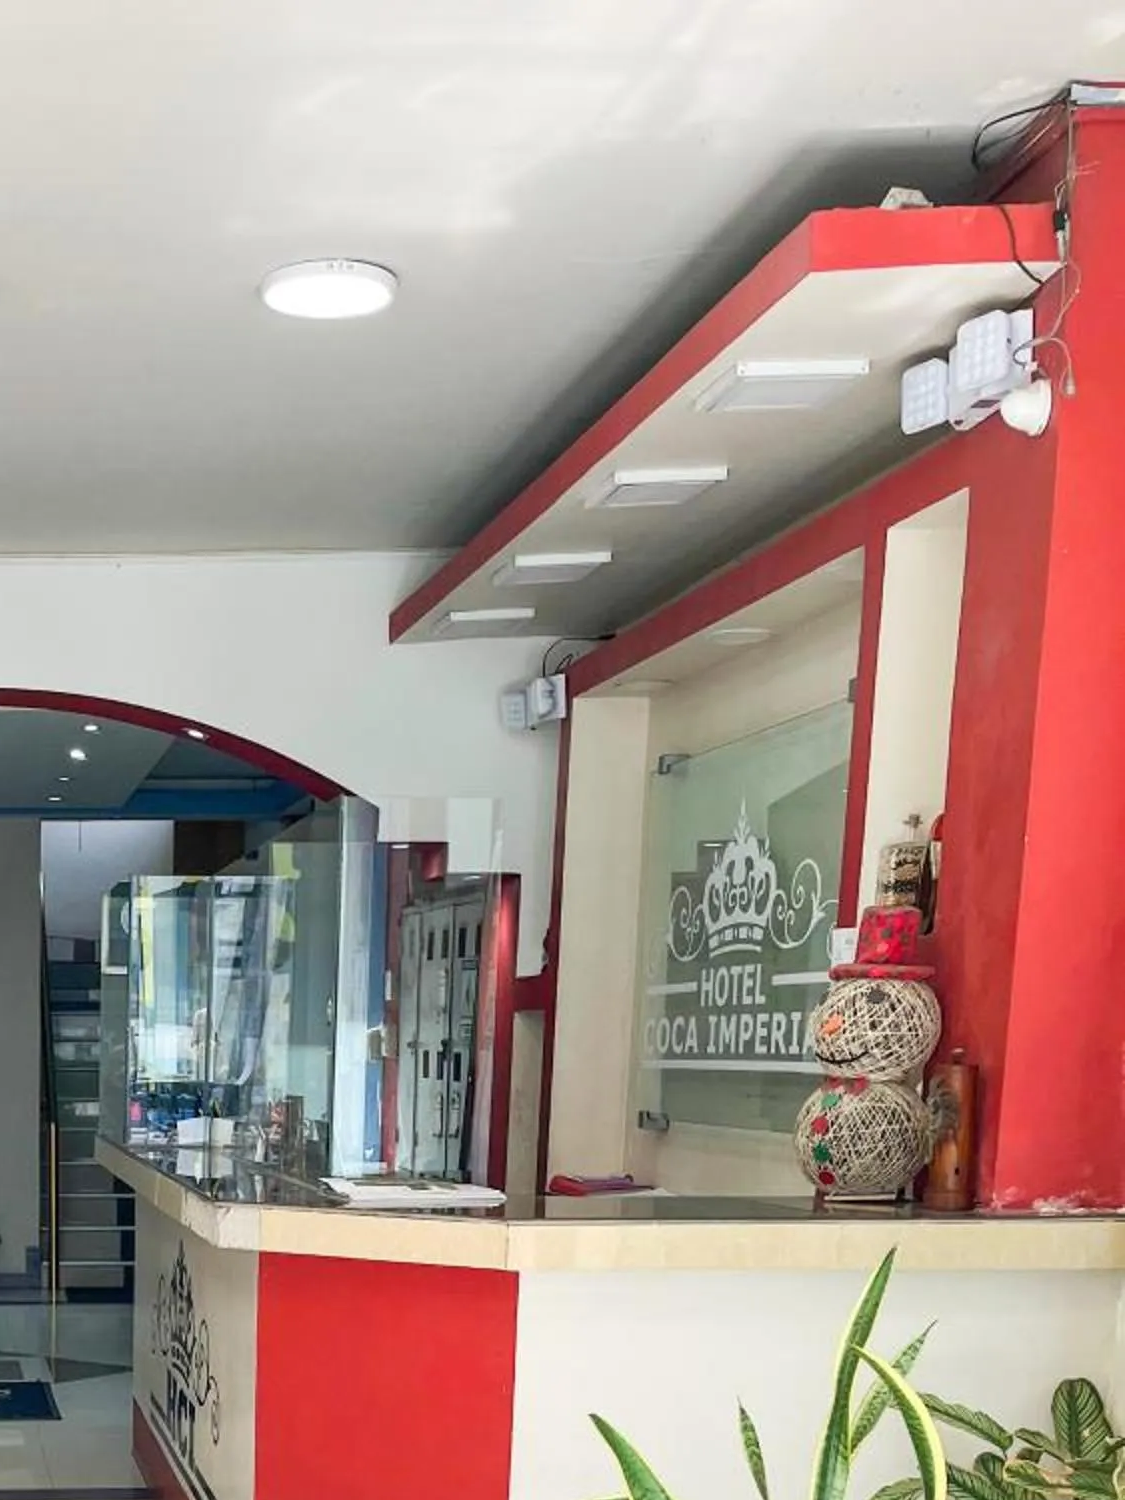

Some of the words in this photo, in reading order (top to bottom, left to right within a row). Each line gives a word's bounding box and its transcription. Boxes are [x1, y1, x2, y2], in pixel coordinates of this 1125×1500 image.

[700, 963, 766, 1007] HOTEL
[644, 1015, 699, 1054] COCA
[707, 1011, 816, 1055] IMPERIA
